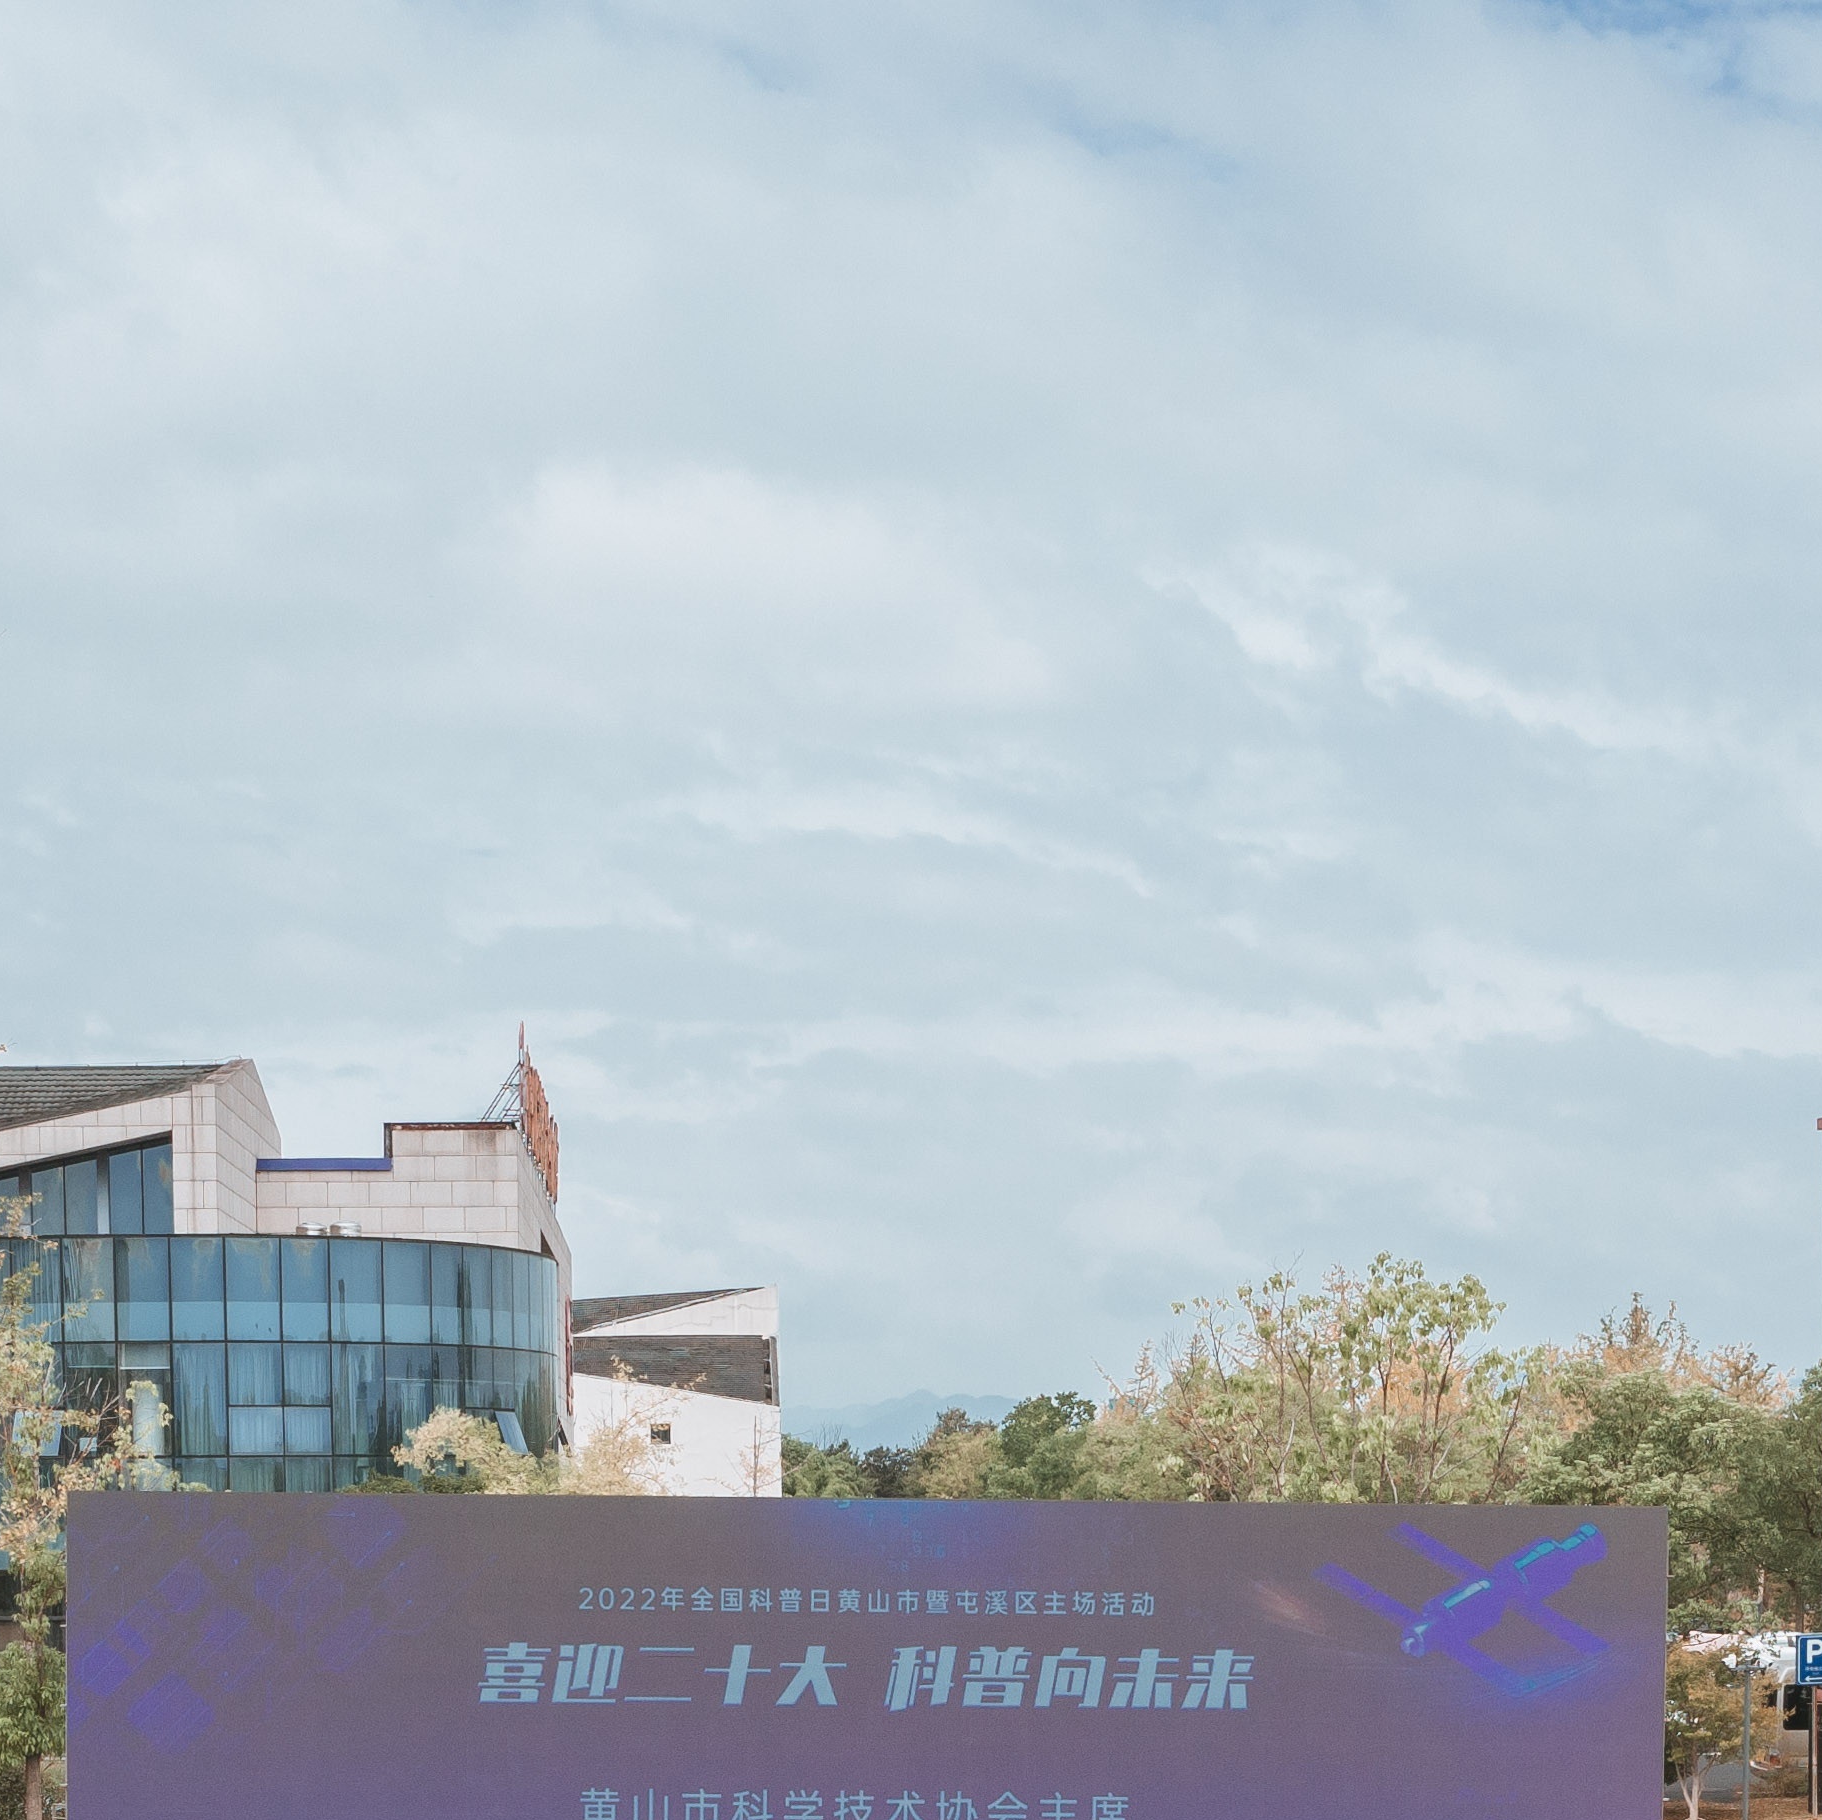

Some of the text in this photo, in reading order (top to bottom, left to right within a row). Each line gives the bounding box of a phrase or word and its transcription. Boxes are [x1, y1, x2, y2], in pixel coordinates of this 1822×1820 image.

[578, 1586, 1155, 1617] 2022年全国科普日黄山市暨屯溪区主场活动
[477, 1642, 1255, 1711] 喜迎二十大 科普向未来
